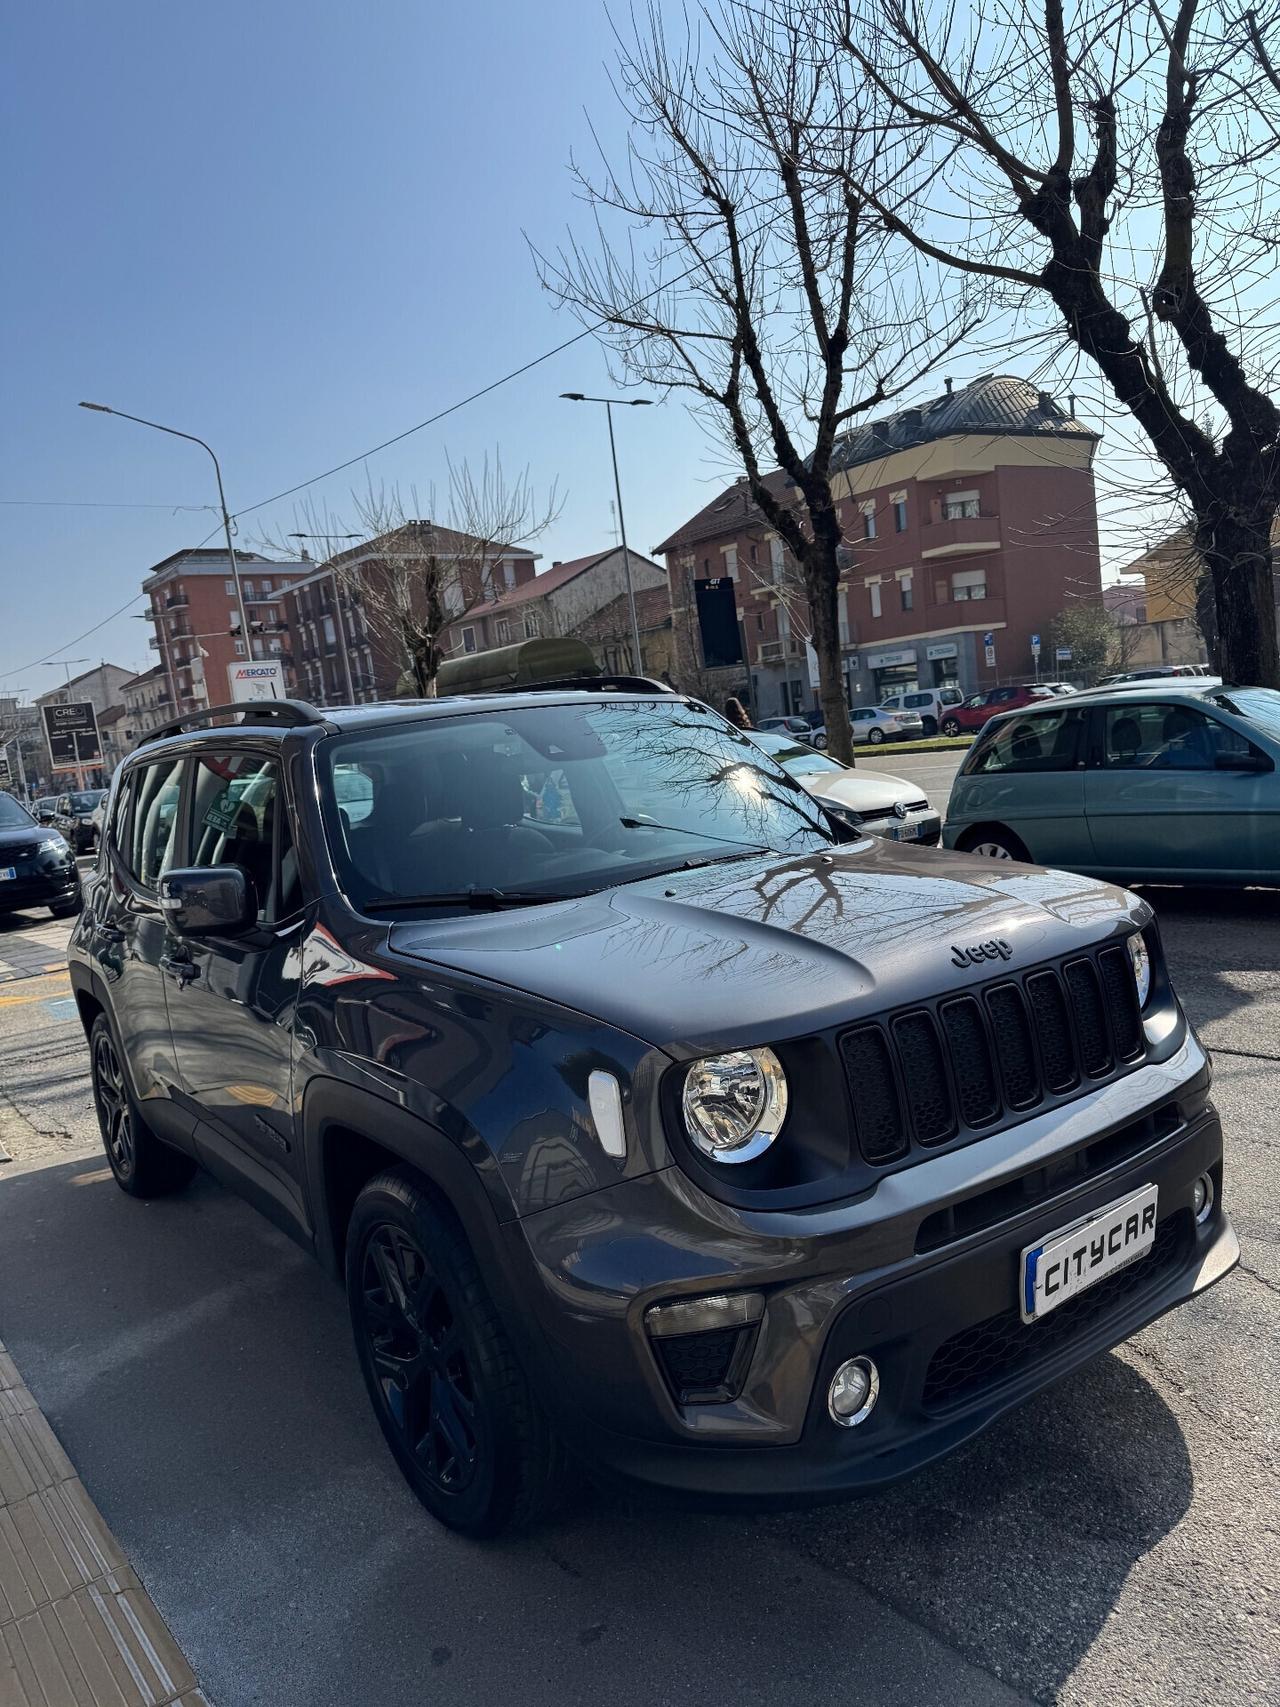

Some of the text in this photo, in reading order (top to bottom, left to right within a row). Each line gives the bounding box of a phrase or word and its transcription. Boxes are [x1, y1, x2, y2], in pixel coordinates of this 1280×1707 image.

[235, 667, 277, 680] MERCATO
[951, 938, 1013, 968] Jeep
[1045, 1203, 1156, 1297] CITYCAR
